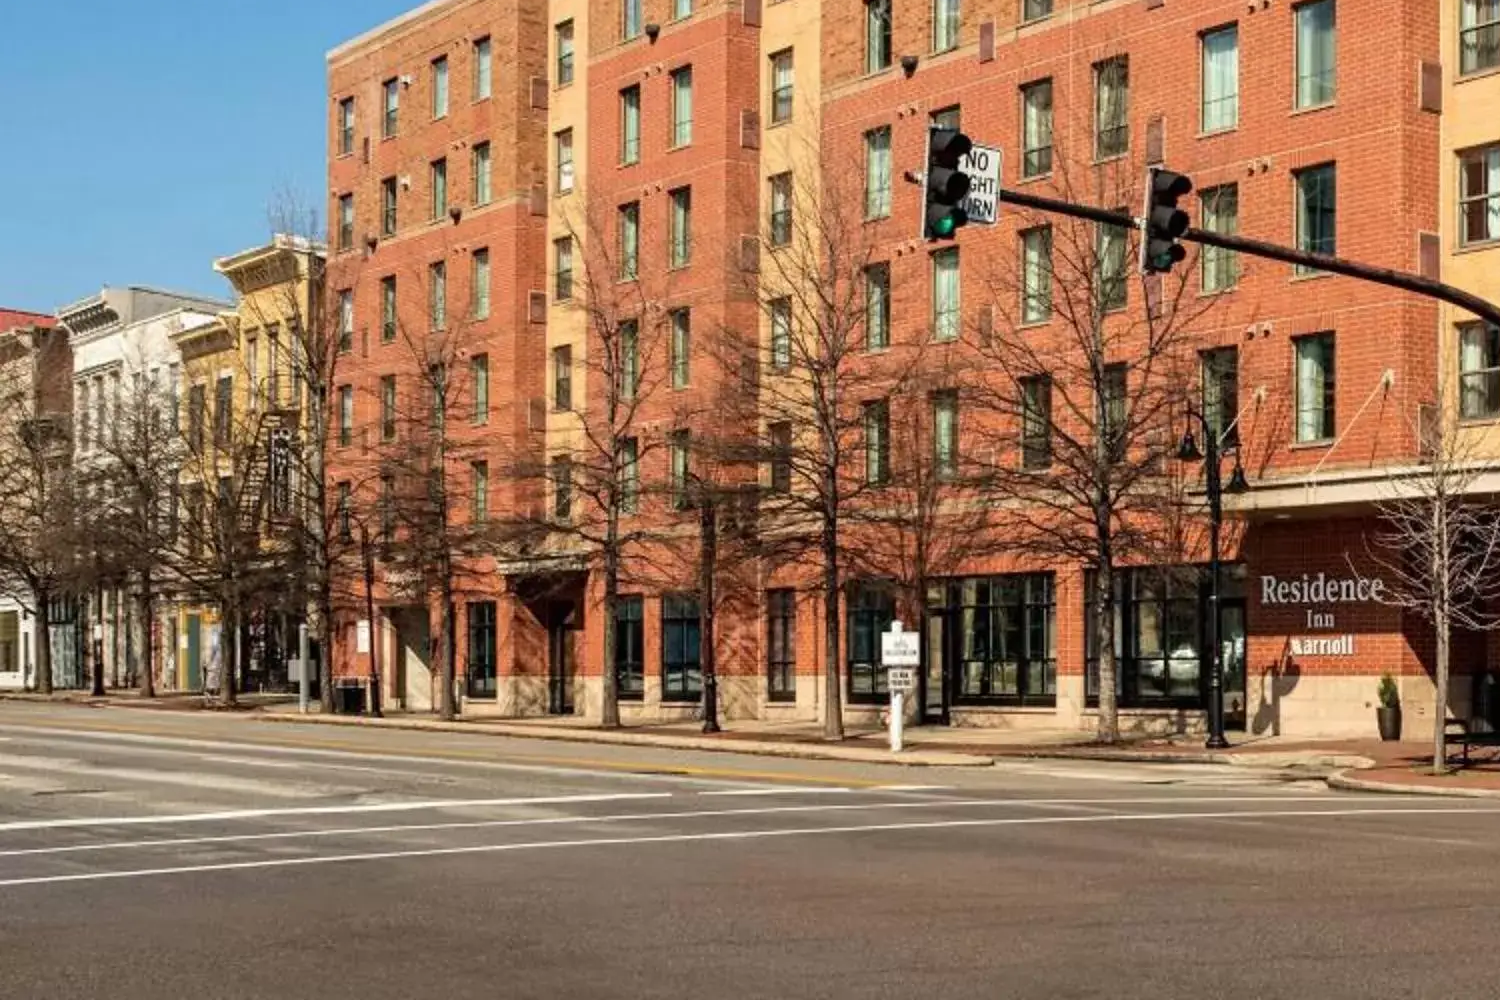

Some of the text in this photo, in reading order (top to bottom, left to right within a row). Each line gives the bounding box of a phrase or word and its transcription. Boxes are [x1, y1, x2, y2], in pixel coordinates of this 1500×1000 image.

[965, 151, 989, 171] NO
[968, 174, 995, 194] GHT
[962, 197, 993, 217] URN
[1261, 572, 1384, 603] Residence
[1306, 609, 1335, 629] Inn
